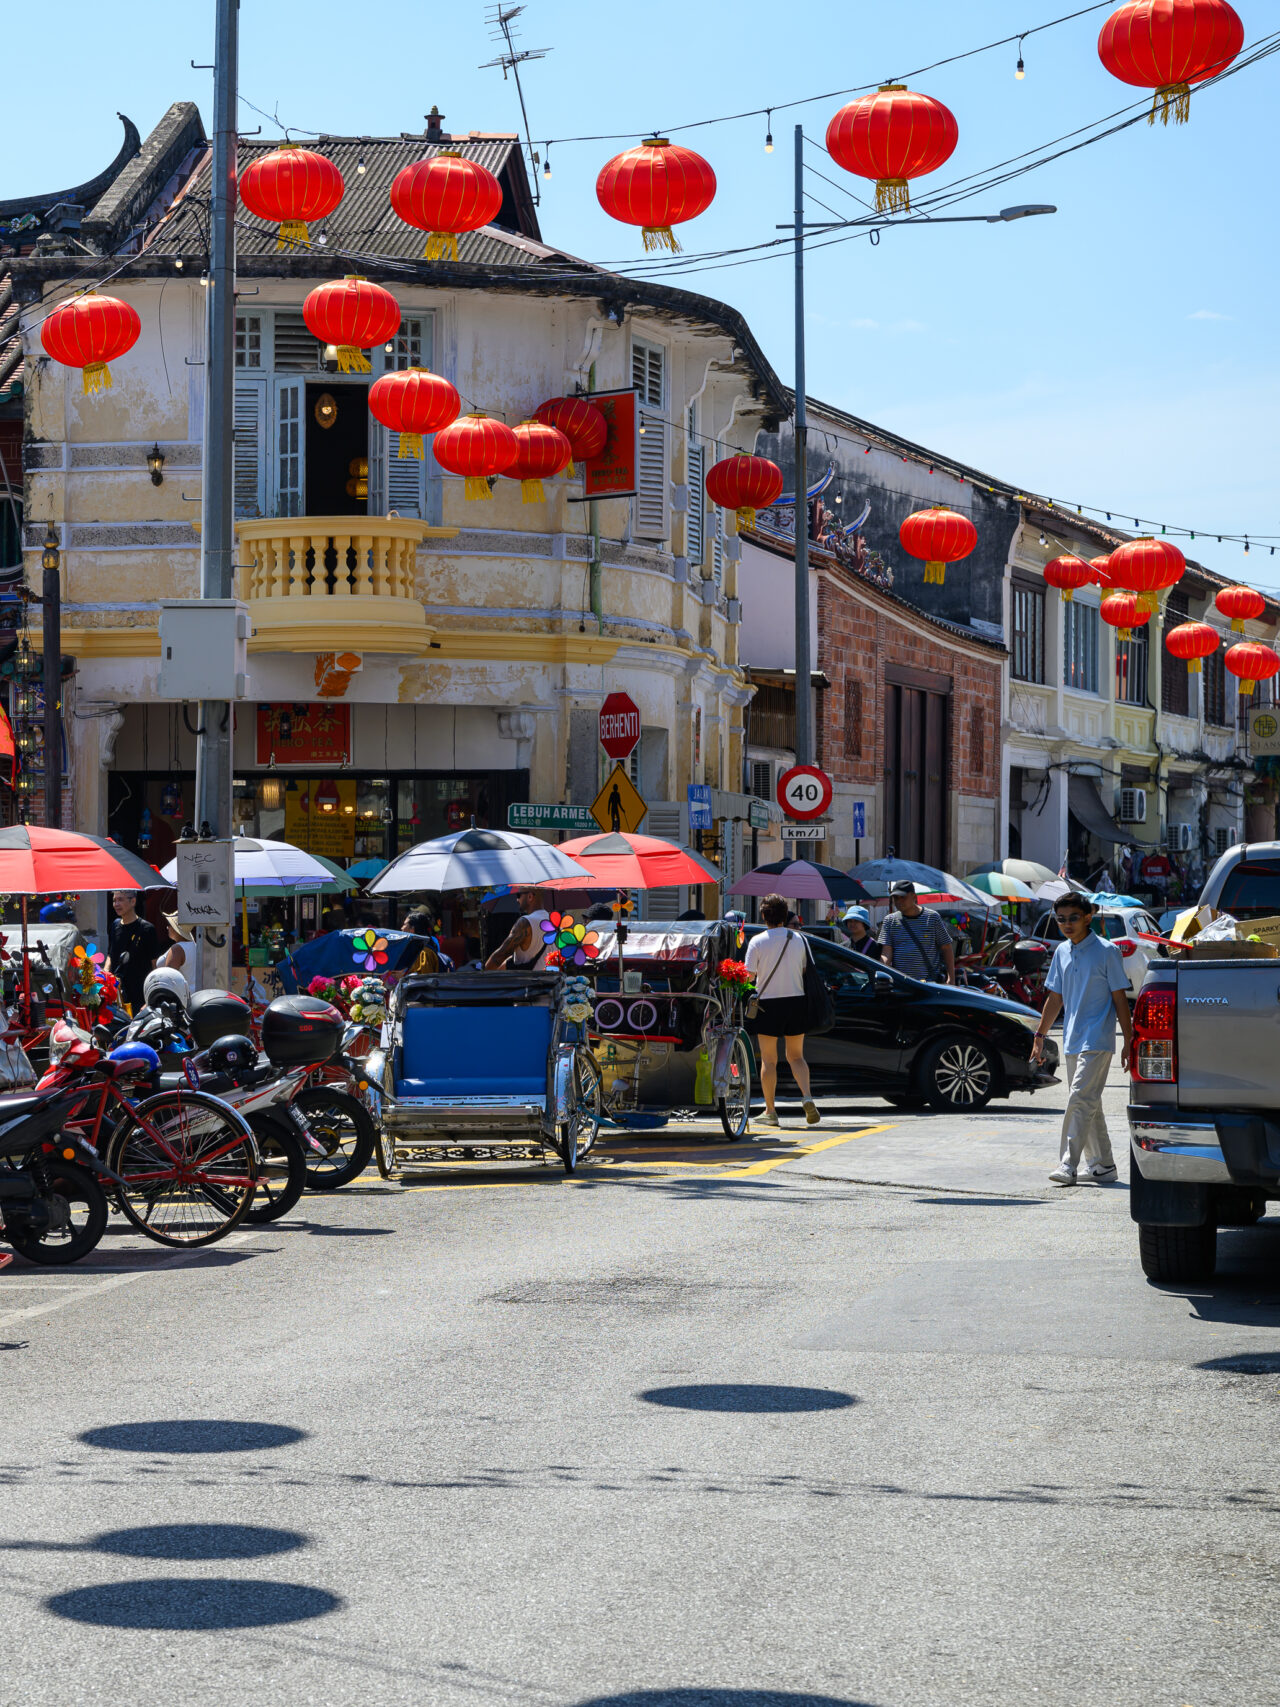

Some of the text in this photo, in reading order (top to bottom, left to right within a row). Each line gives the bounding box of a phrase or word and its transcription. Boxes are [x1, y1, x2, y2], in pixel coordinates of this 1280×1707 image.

[600, 712, 638, 740] BERHENTI
[790, 784, 818, 801] 40
[513, 806, 551, 818] LEBUH
[1184, 997, 1229, 1006] TOYOTA
